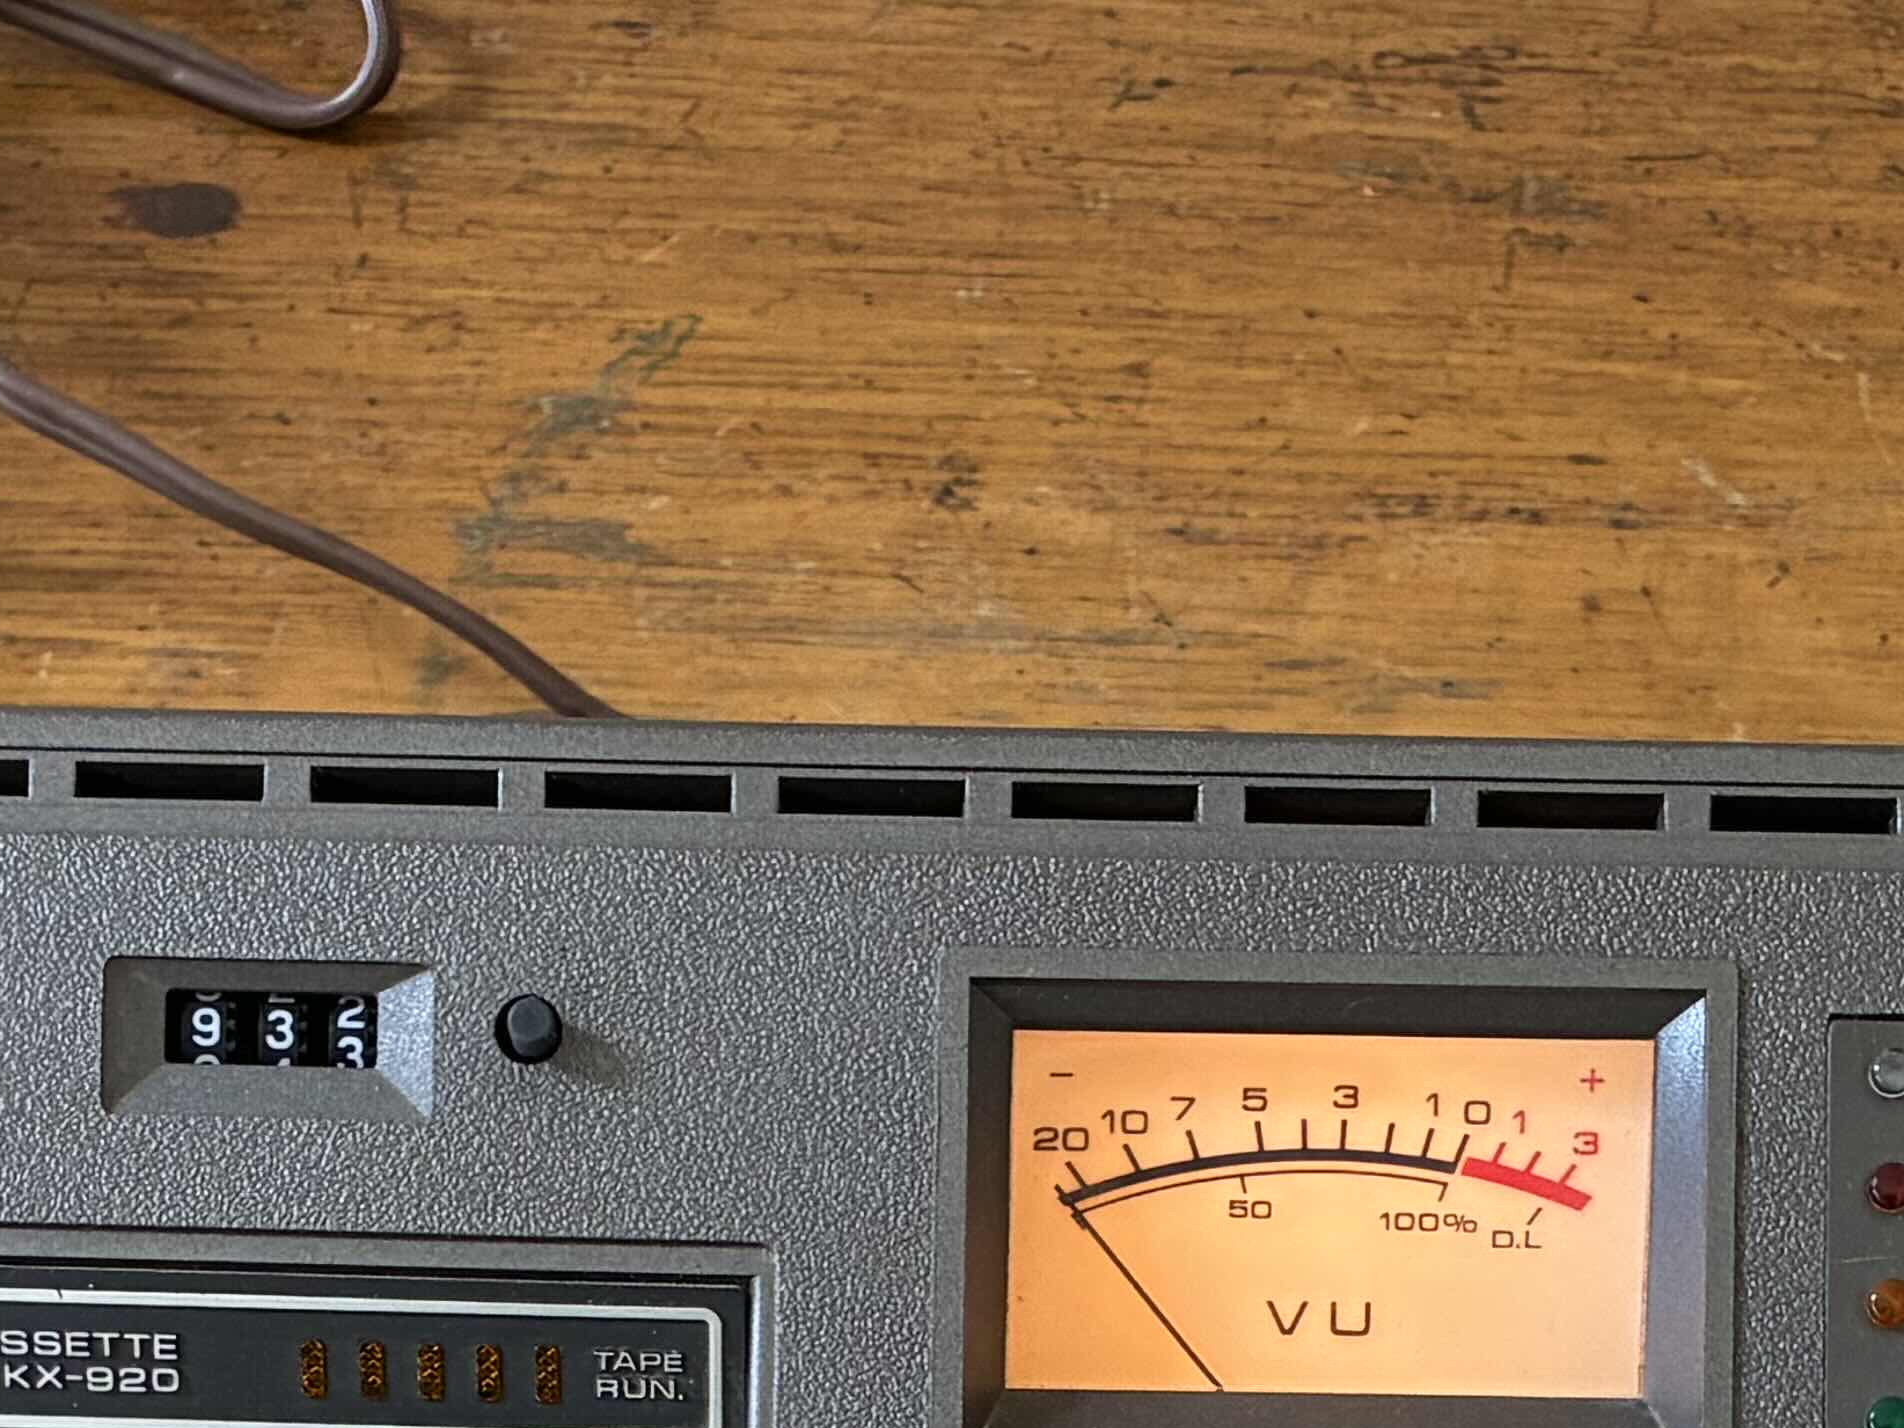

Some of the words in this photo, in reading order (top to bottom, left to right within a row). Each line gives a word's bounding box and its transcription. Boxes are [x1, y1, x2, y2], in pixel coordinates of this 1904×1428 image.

[1032, 1126, 1090, 1152] 20
[1101, 1109, 1149, 1135] 10
[1170, 1095, 1196, 1121] 7
[1241, 1087, 1268, 1112] 5
[1332, 1084, 1359, 1109] 3
[1426, 1092, 1439, 1117] 1
[1463, 1100, 1492, 1126] 0
[1512, 1109, 1526, 1135] 1
[1572, 1131, 1600, 1156] 3
[1228, 1199, 1272, 1220] 50
[1379, 1212, 1478, 1234] 100%
[593, 1349, 683, 1373] TAPE
[3, 1363, 179, 1393] KX-920
